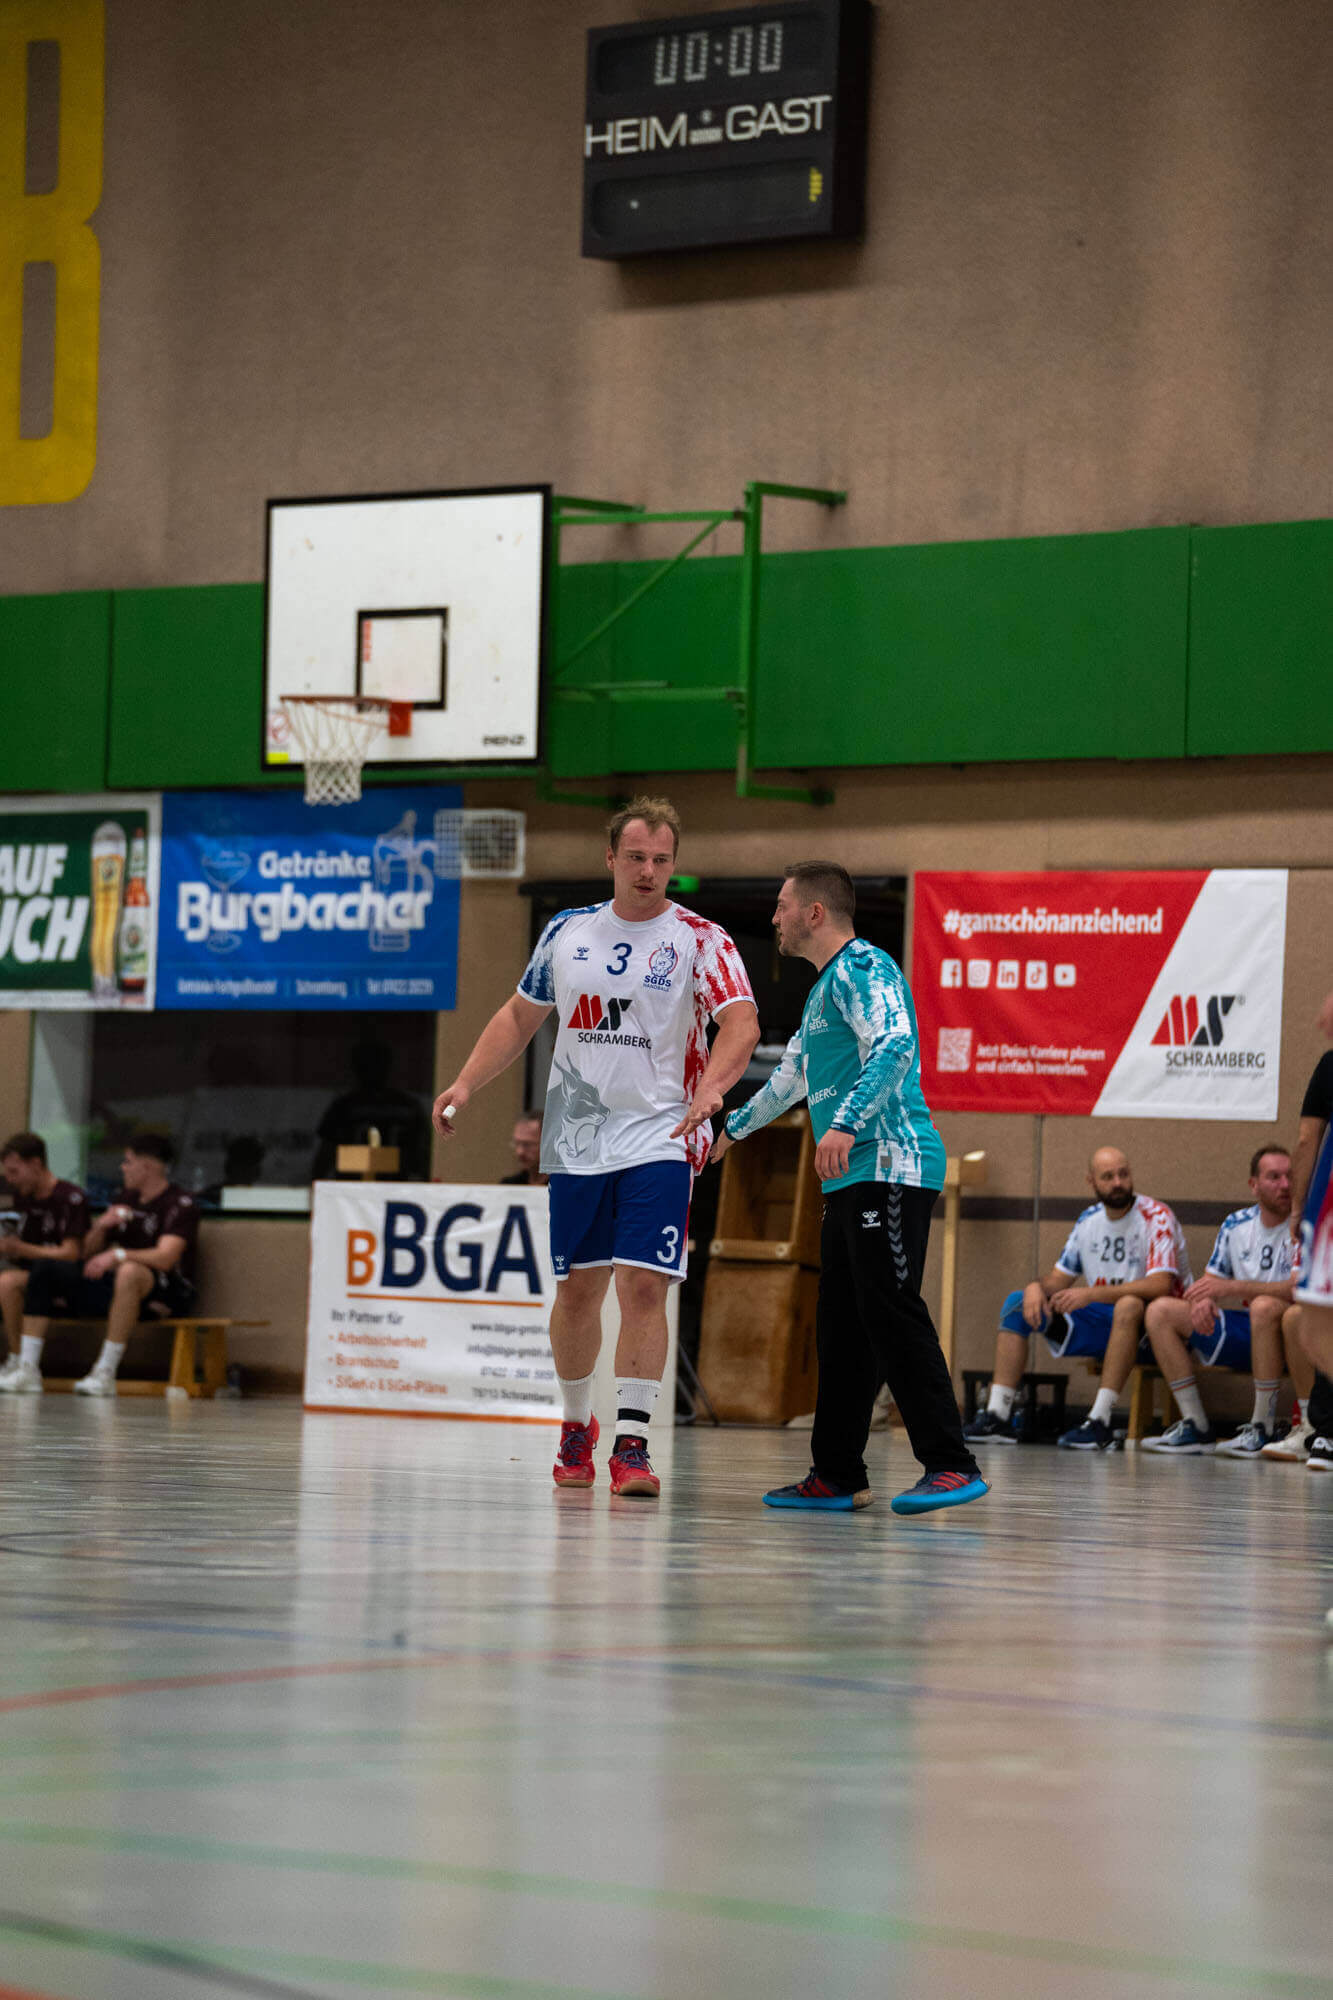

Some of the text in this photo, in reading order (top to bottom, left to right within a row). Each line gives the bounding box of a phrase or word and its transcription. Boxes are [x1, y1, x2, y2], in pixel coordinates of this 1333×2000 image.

[585, 95, 832, 157] HEIM GAST
[0, 843, 69, 897] AUF
[258, 850, 371, 879] Getränke
[177, 882, 434, 943] Burgbacher
[942, 907, 1163, 939] #ganzschönanziehend
[606, 942, 633, 976] 3
[644, 975, 672, 988] SGDS
[1165, 1051, 1266, 1069] SCHRAMBERG
[656, 1225, 679, 1264] 3
[1100, 1236, 1126, 1263] 28
[1260, 1244, 1274, 1270] 8
